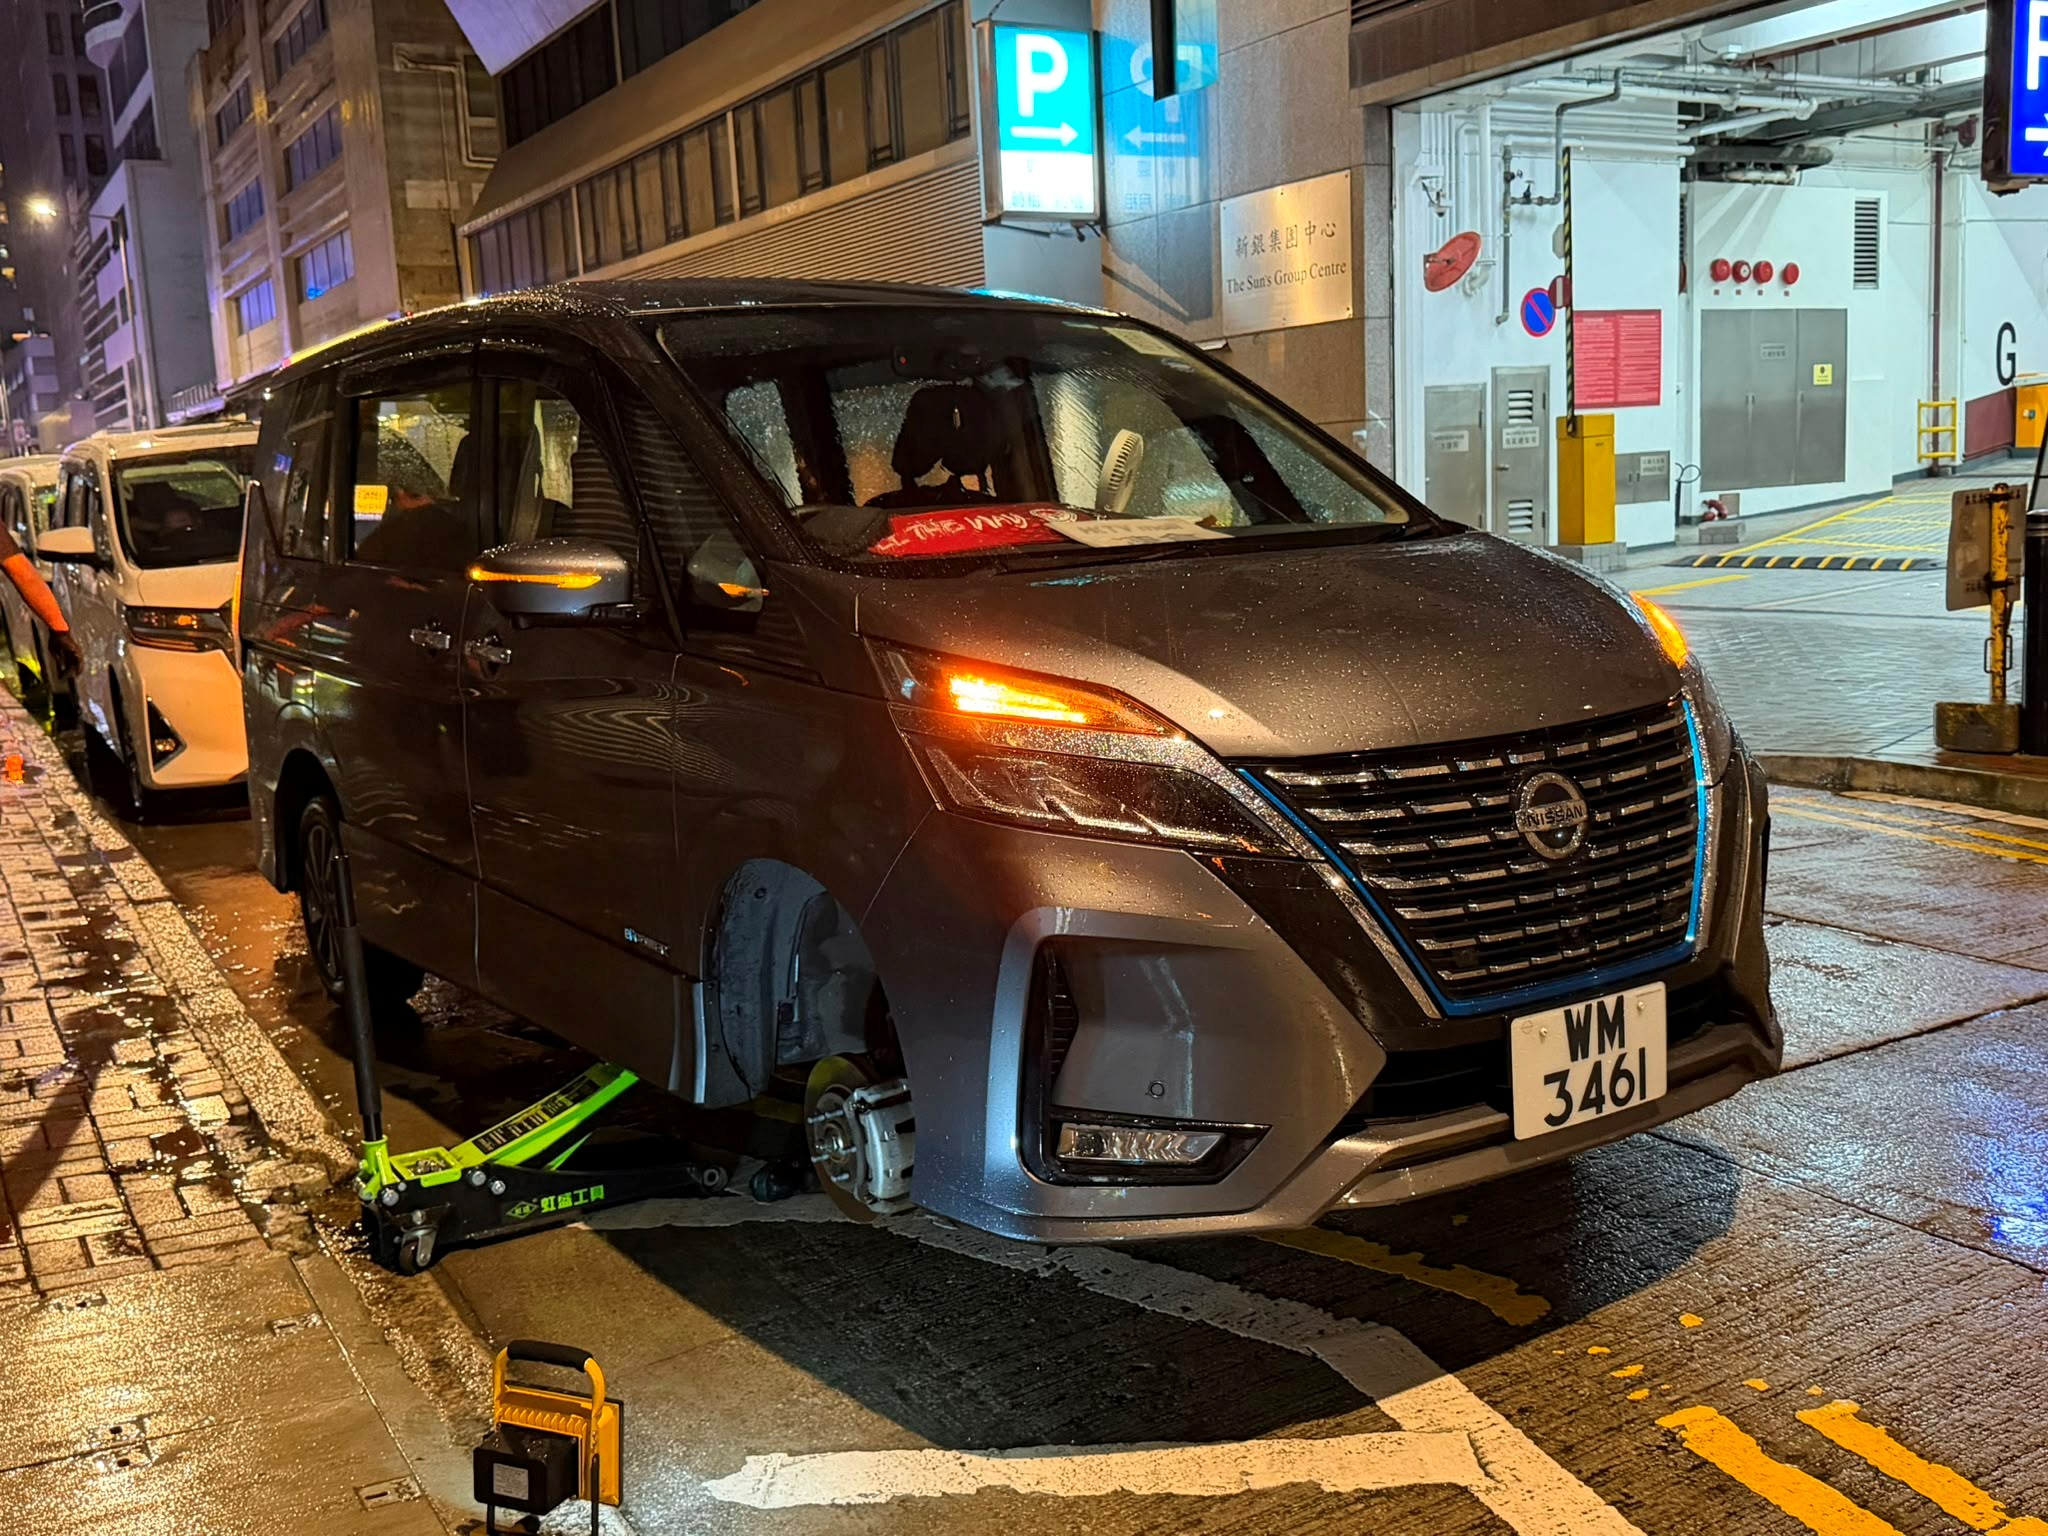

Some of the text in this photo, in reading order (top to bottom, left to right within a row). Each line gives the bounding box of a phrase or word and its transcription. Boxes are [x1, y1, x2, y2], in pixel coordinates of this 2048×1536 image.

[1016, 33, 1069, 118] P
[1235, 220, 1336, 259] 新銀集團中心
[1227, 261, 1347, 294] The Sun's Group Centre
[1996, 322, 2016, 386] G
[1526, 804, 1583, 827] NISSAN
[1563, 994, 1625, 1063] WM
[1543, 1047, 1647, 1127] 3461
